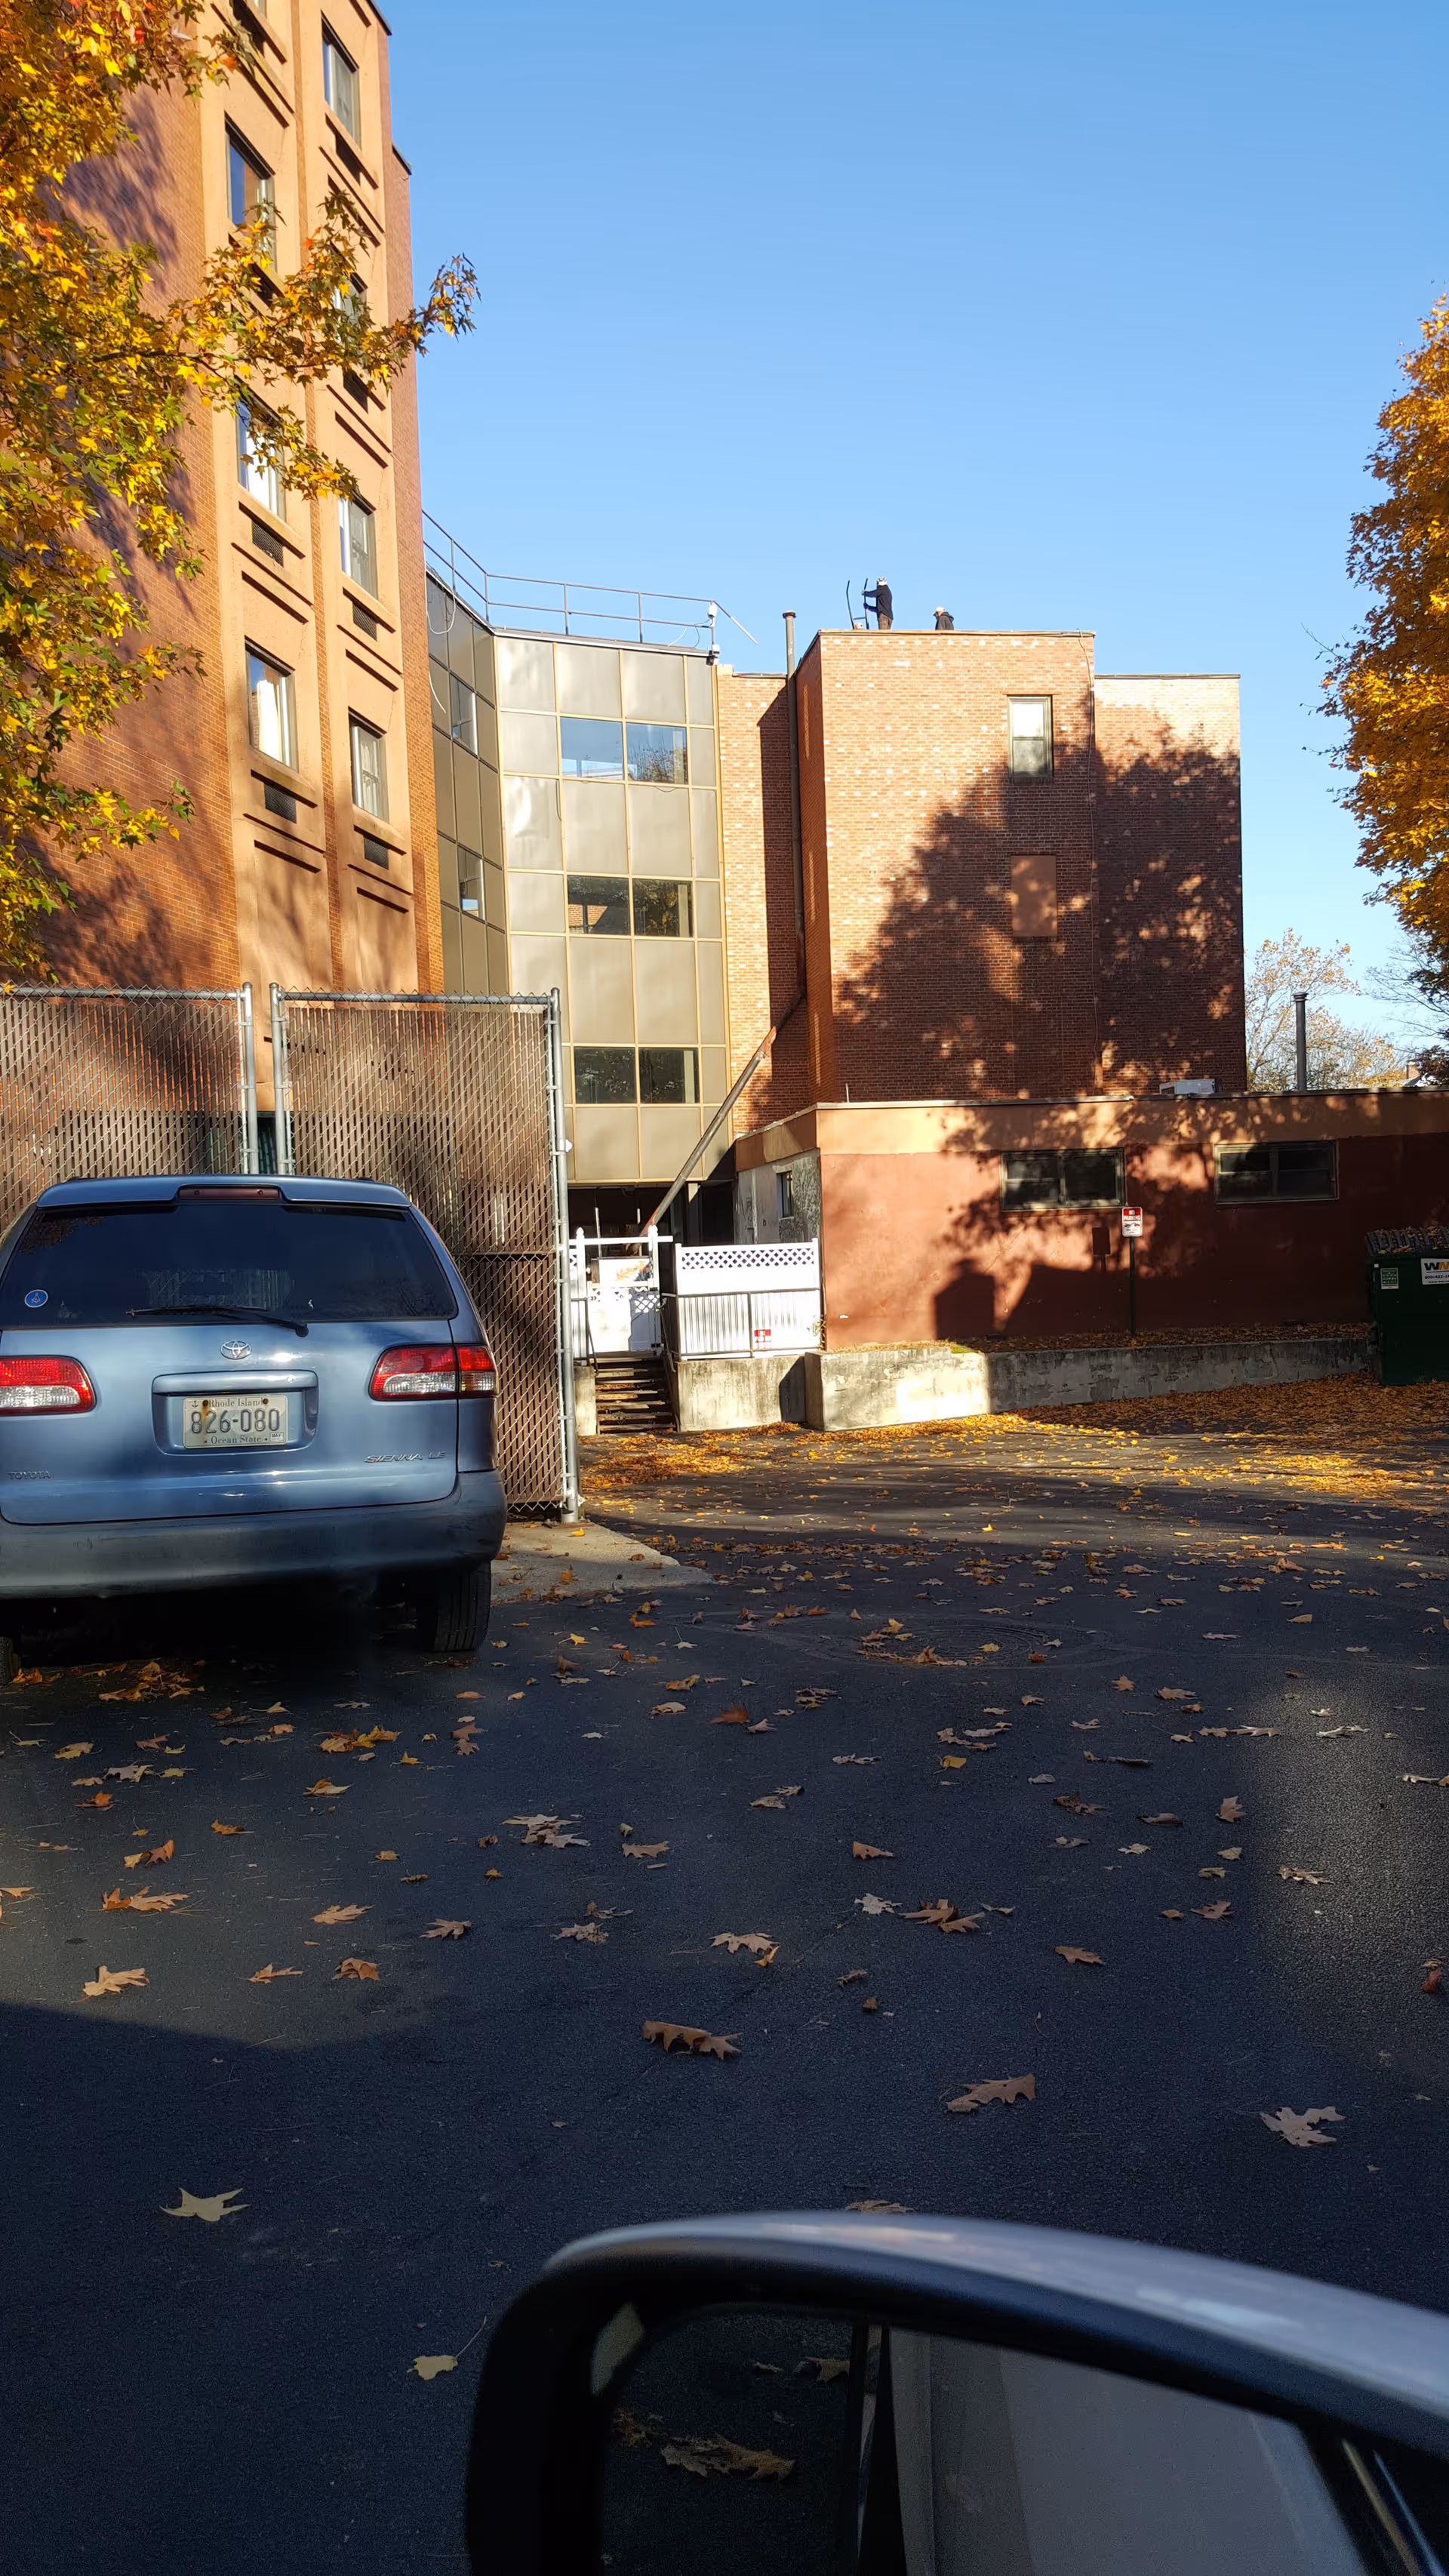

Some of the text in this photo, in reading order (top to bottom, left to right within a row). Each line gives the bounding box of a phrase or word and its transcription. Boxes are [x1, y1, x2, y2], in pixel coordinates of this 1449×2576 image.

[209, 1397, 263, 1408] Rhode Island
[191, 1408, 280, 1434] 826-080
[211, 1435, 262, 1444] Ocean State
[364, 1451, 447, 1463] SIENNA LE
[8, 1470, 51, 1479] TOYOTA
